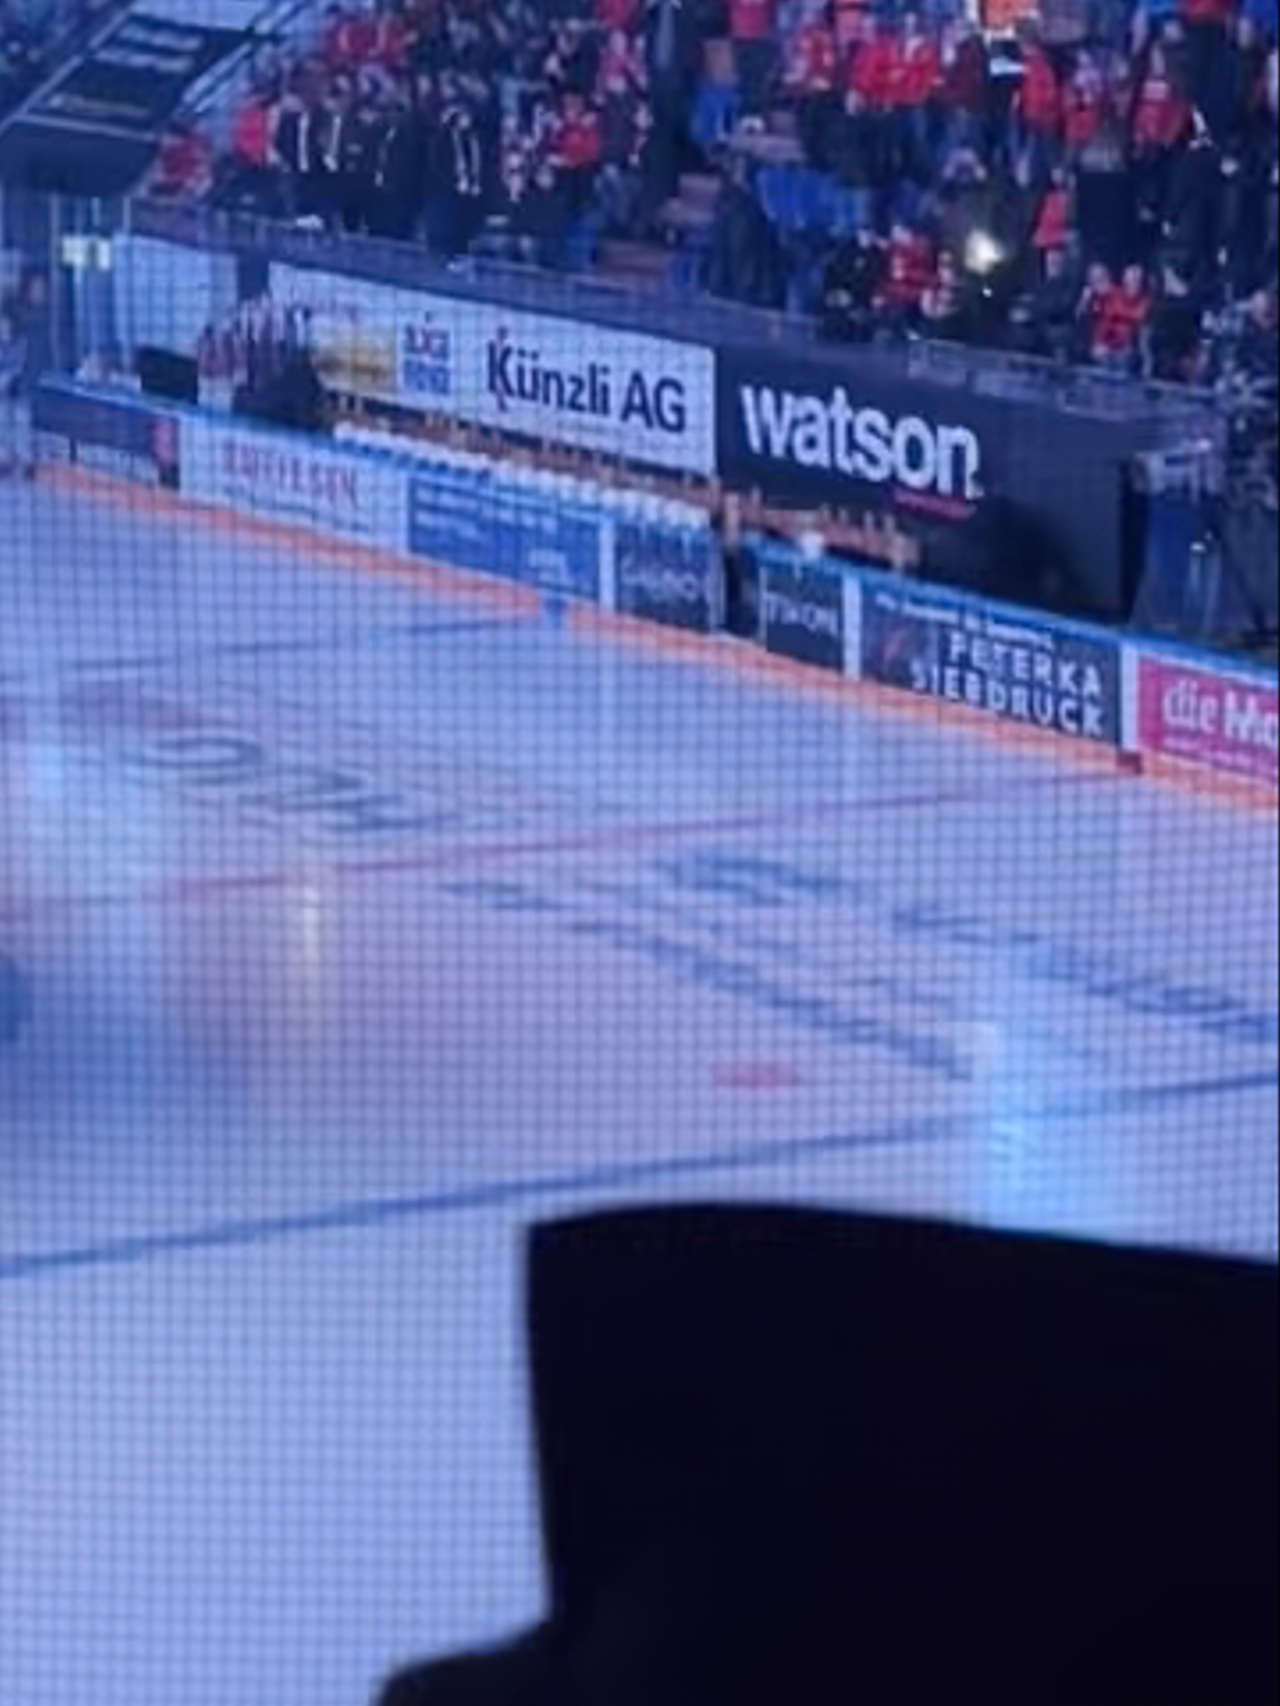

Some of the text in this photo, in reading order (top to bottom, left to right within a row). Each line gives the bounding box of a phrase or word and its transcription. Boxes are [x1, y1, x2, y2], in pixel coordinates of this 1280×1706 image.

[486, 331, 611, 416] Künzli
[621, 370, 687, 434] AG
[741, 385, 981, 500] watson
[909, 658, 1103, 736] SIEBDRUCK
[949, 630, 1102, 697] PETERKA
[1163, 680, 1217, 735] die
